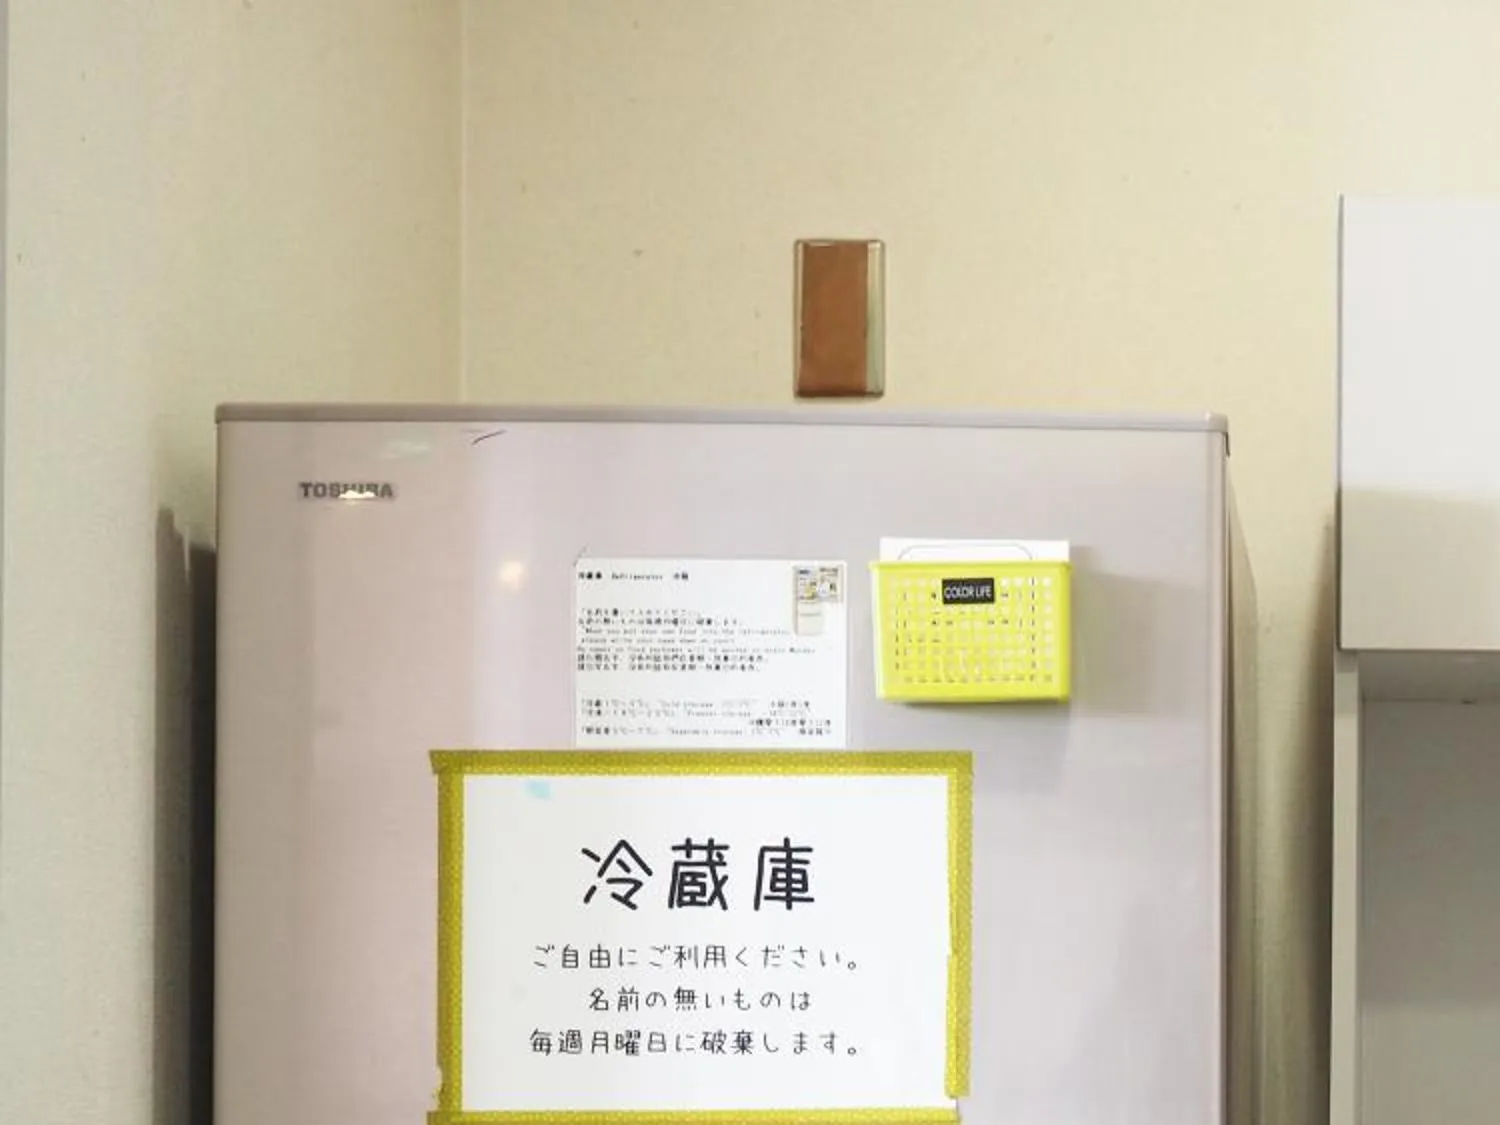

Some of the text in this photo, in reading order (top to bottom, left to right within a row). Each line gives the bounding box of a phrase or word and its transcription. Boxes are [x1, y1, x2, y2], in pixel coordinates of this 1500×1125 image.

[944, 585, 992, 599] COLOR LIFE
[582, 837, 815, 911] 冷蔵庫
[533, 944, 858, 971] ご自由にご利用ください。
[588, 987, 811, 1012] 名前の無いものは
[529, 1029, 858, 1057] 毎週月曜日に破棄します。
